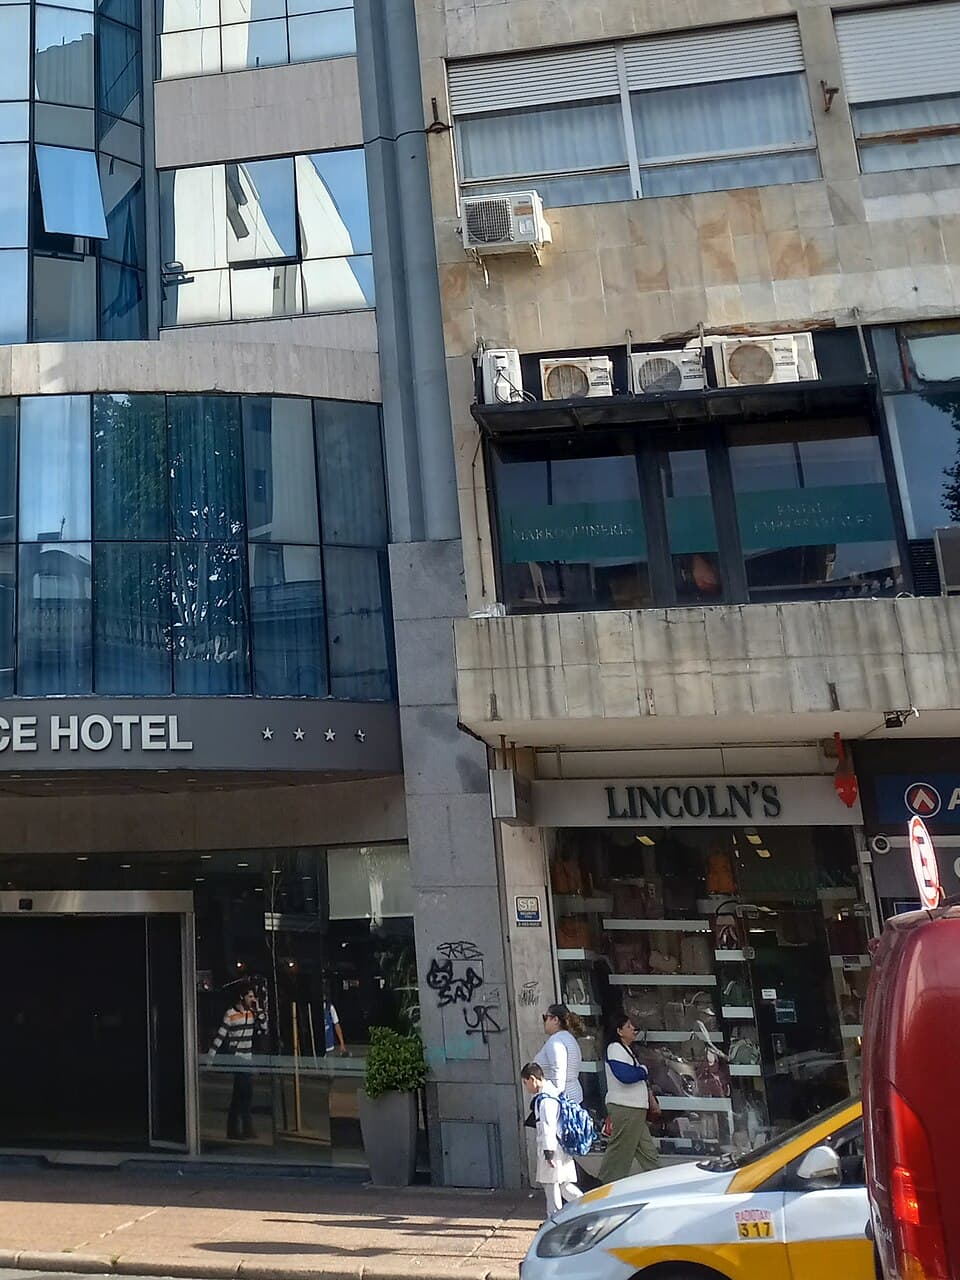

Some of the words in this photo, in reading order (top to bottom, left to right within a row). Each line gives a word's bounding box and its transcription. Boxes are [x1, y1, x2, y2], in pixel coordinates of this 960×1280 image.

[50, 714, 193, 751] HOTEL
[604, 781, 782, 819] LINCOLN'S
[741, 1222, 770, 1237] 317
